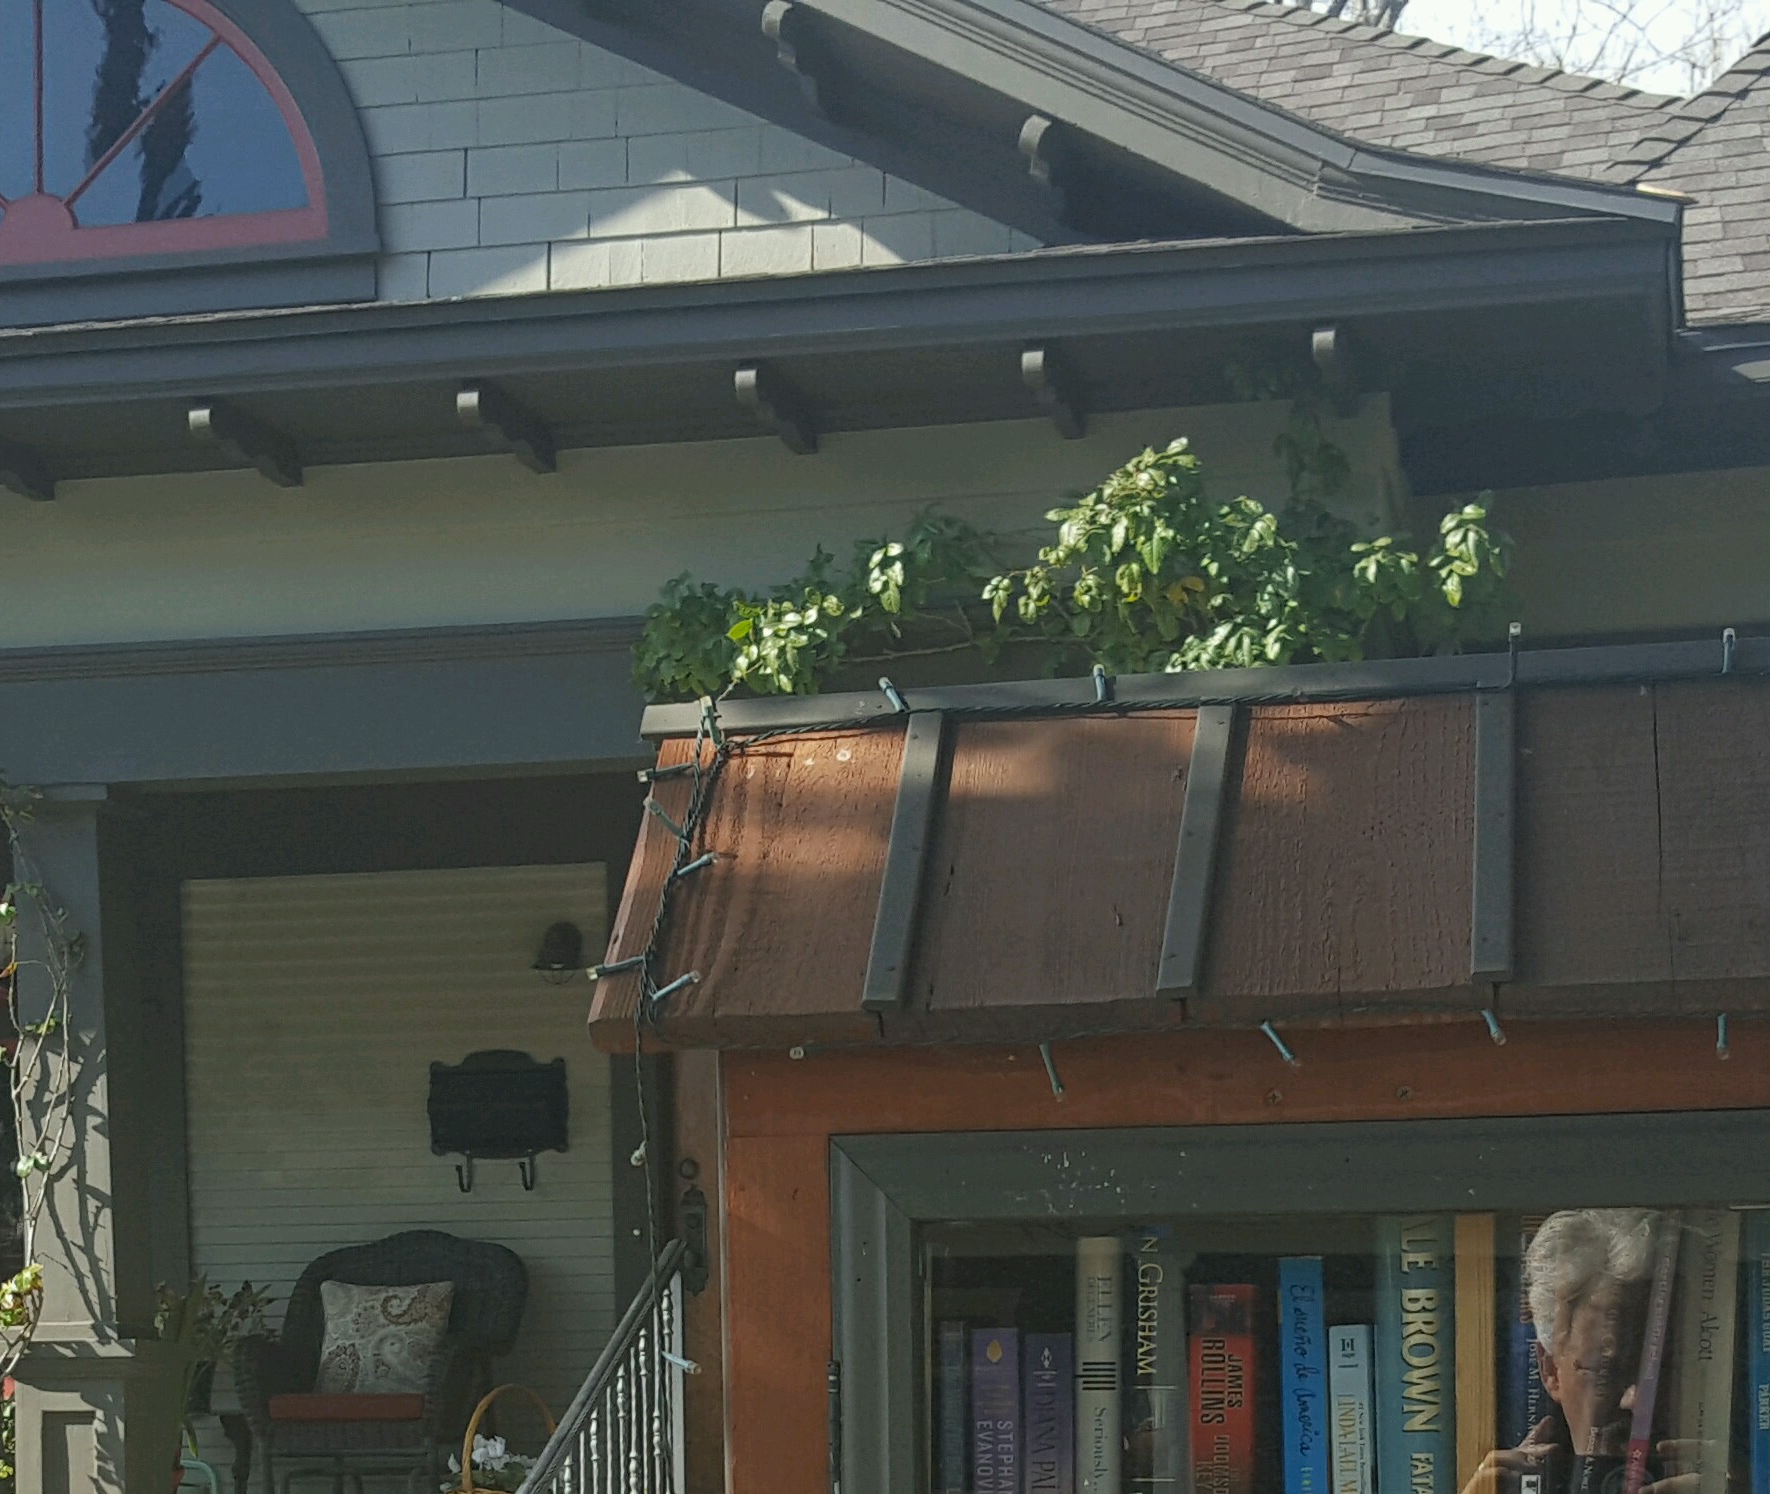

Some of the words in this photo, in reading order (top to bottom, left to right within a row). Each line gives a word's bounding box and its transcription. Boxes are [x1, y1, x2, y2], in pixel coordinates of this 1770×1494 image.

[1096, 1276, 1114, 1343] ELLEN
[1137, 1259, 1163, 1376] GRISHAM
[1291, 1284, 1315, 1303] El
[1200, 1338, 1226, 1425] ROLLINS
[1226, 1354, 1243, 1409] JAMES
[1294, 1363, 1320, 1379] de
[1401, 1288, 1442, 1434] BROWN
[1758, 1384, 1770, 1430] PARKER
[1195, 1460, 1213, 1491] KEY
